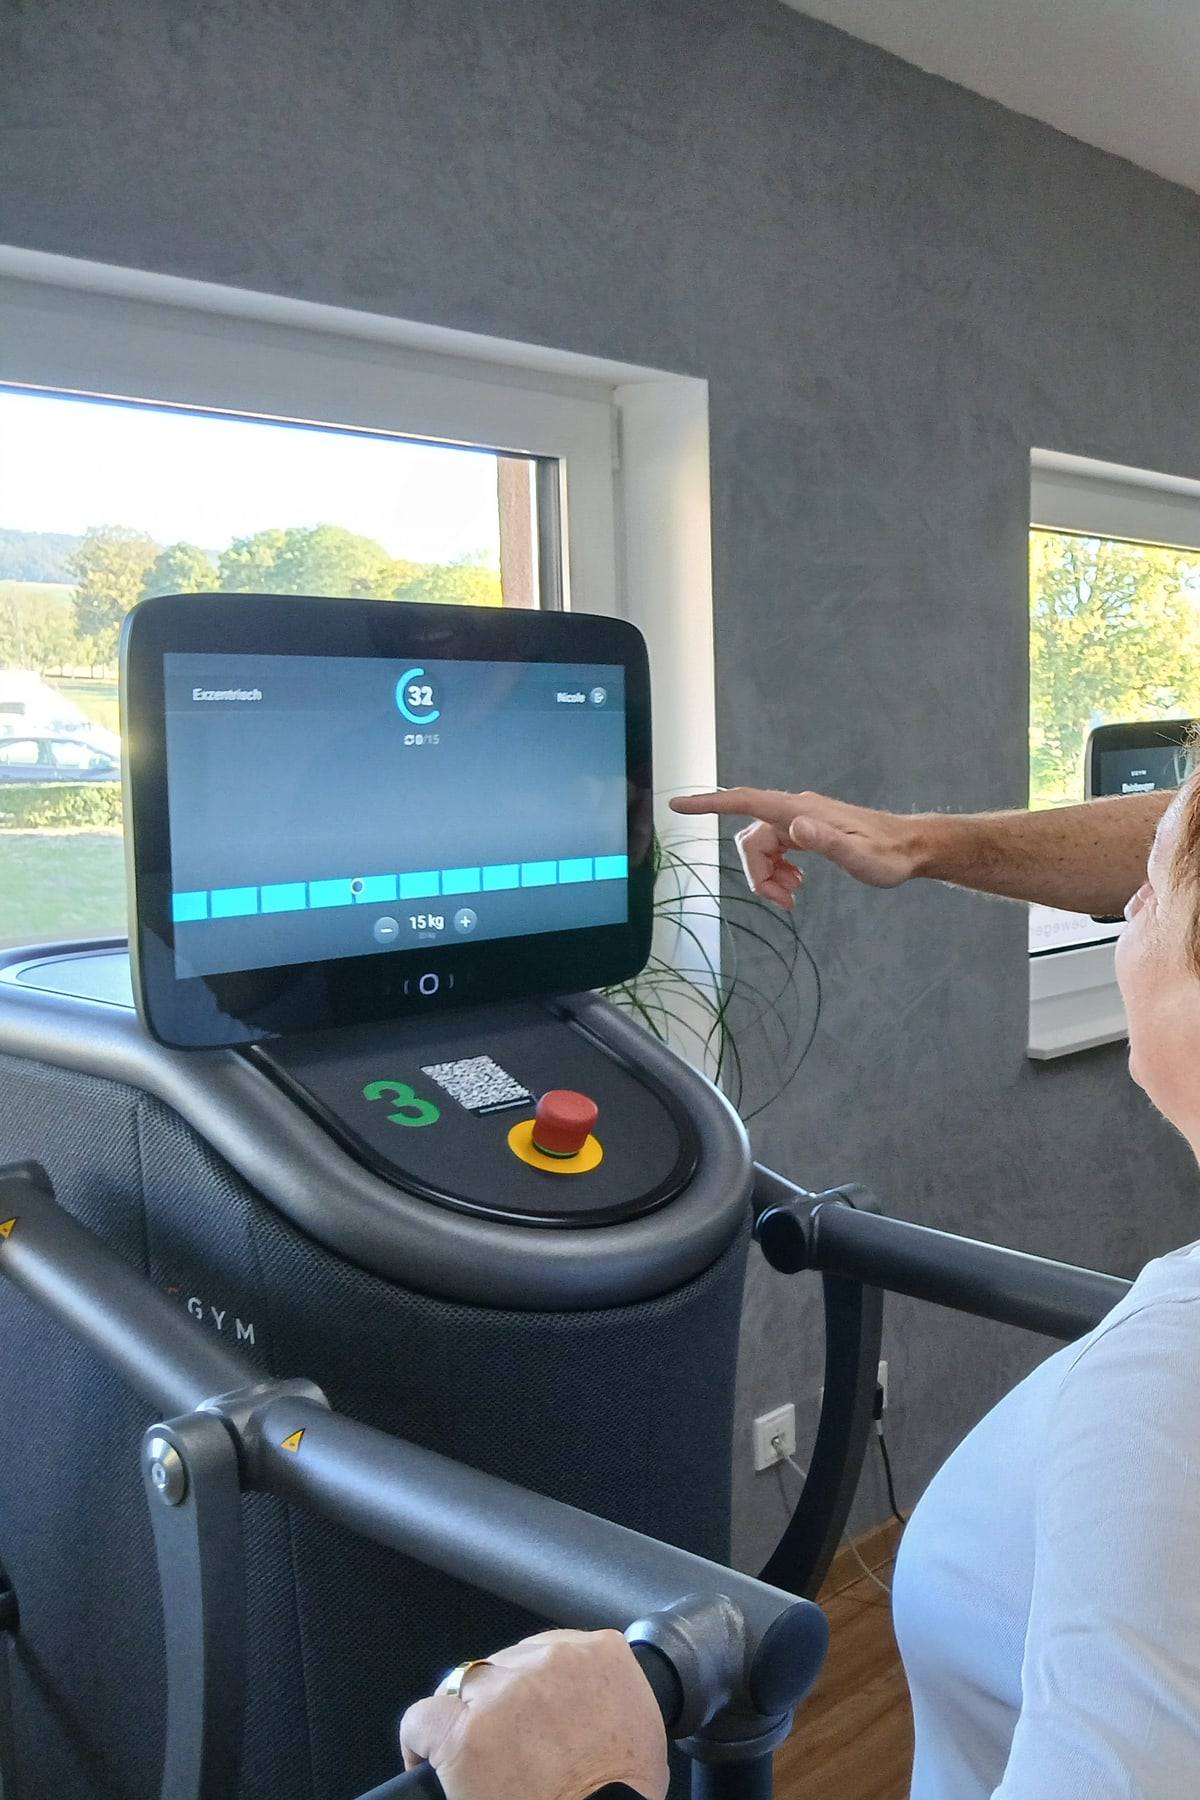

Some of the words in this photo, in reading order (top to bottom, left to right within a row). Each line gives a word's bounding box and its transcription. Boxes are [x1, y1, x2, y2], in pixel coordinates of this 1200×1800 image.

[408, 685, 433, 706] 32
[363, 1080, 440, 1127] 3
[165, 1286, 255, 1345] GYM
